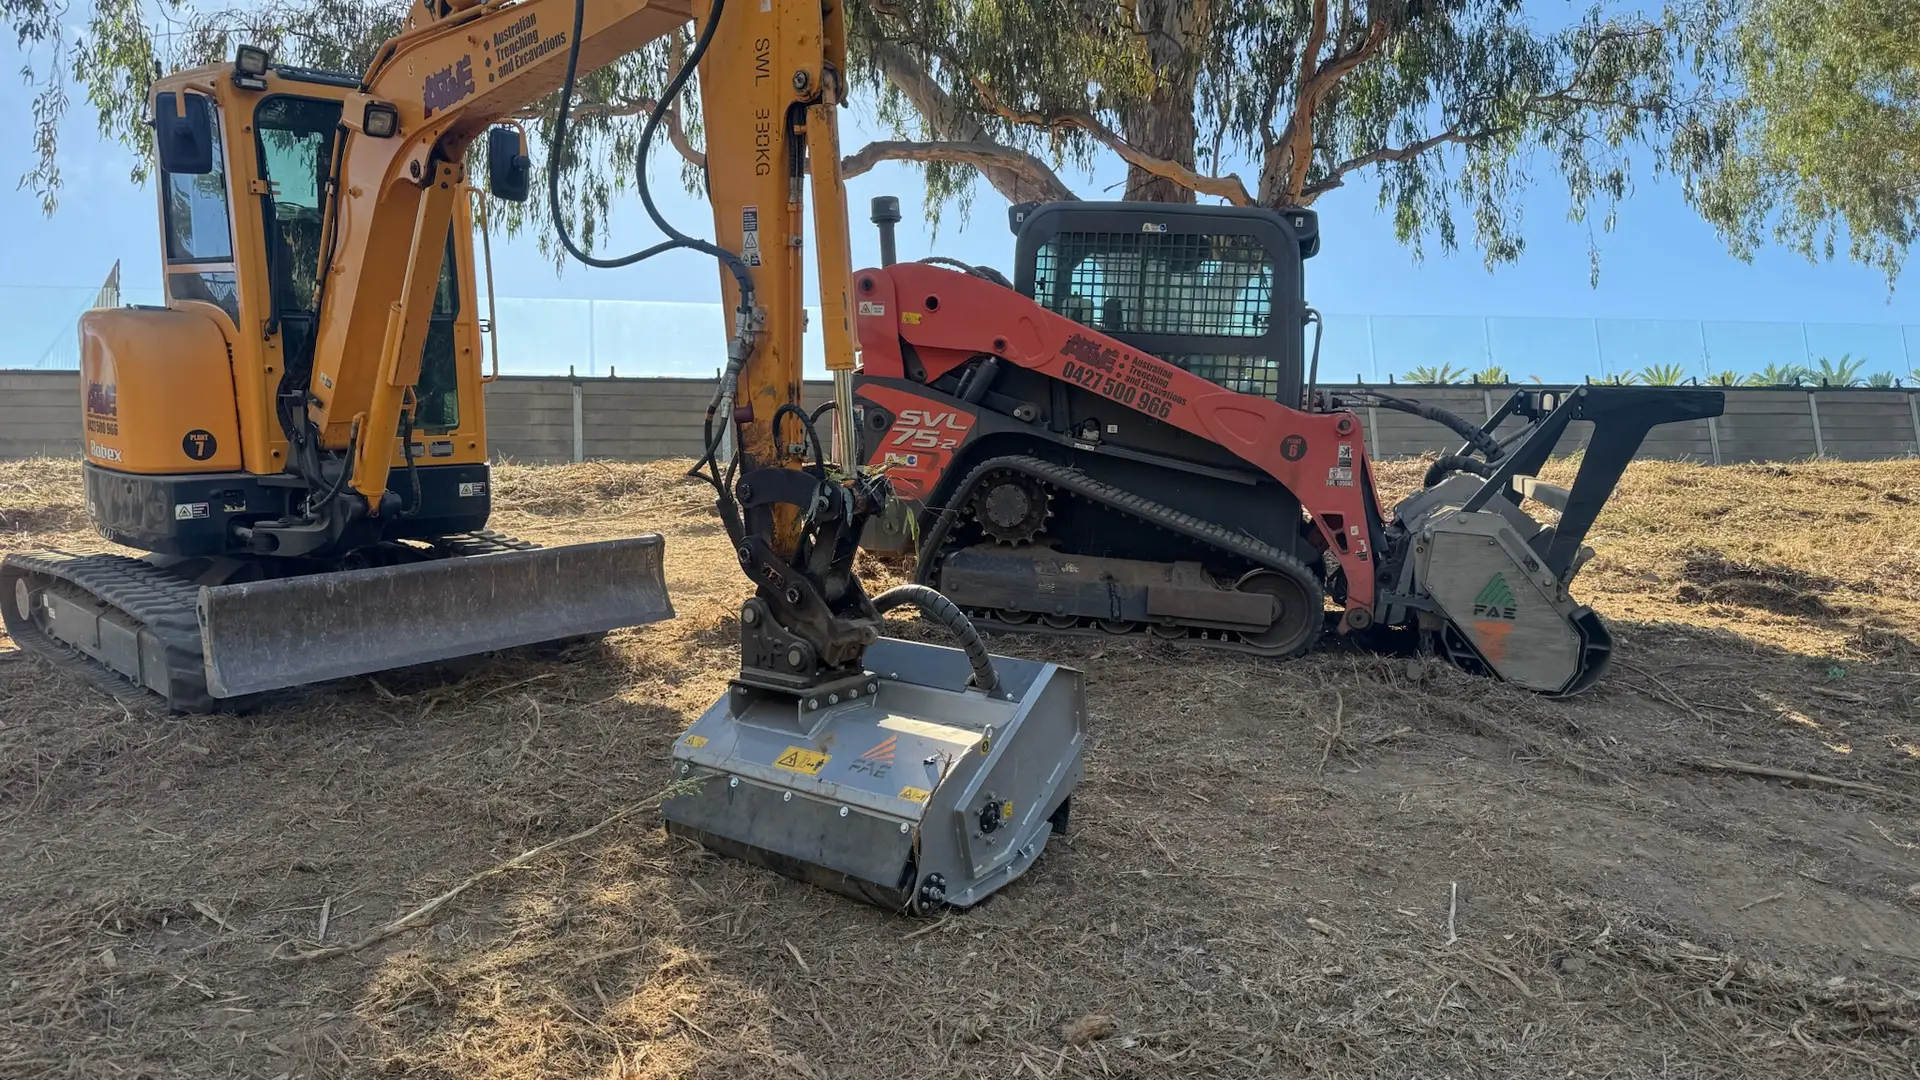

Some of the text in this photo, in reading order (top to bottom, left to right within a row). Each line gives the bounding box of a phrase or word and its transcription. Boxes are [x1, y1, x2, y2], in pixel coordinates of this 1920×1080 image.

[494, 13, 537, 47] Australian
[495, 29, 539, 62] Trenching
[498, 31, 567, 78] and Excavations
[755, 38, 771, 176] SWL 330KG
[1129, 366, 1169, 389] Trenching
[1132, 356, 1174, 380] Australian
[1062, 361, 1173, 419] 0427 500 966
[1124, 375, 1188, 406] and Excavations
[106, 423, 119, 436] 966
[896, 410, 968, 430] SVL
[190, 434, 208, 442] PLANT
[195, 441, 205, 457] 7
[892, 427, 957, 449] 75-2
[90, 440, 122, 463] Robex
[1288, 444, 1298, 458] 6
[1473, 604, 1518, 620] FAE
[848, 759, 891, 778] FAE
